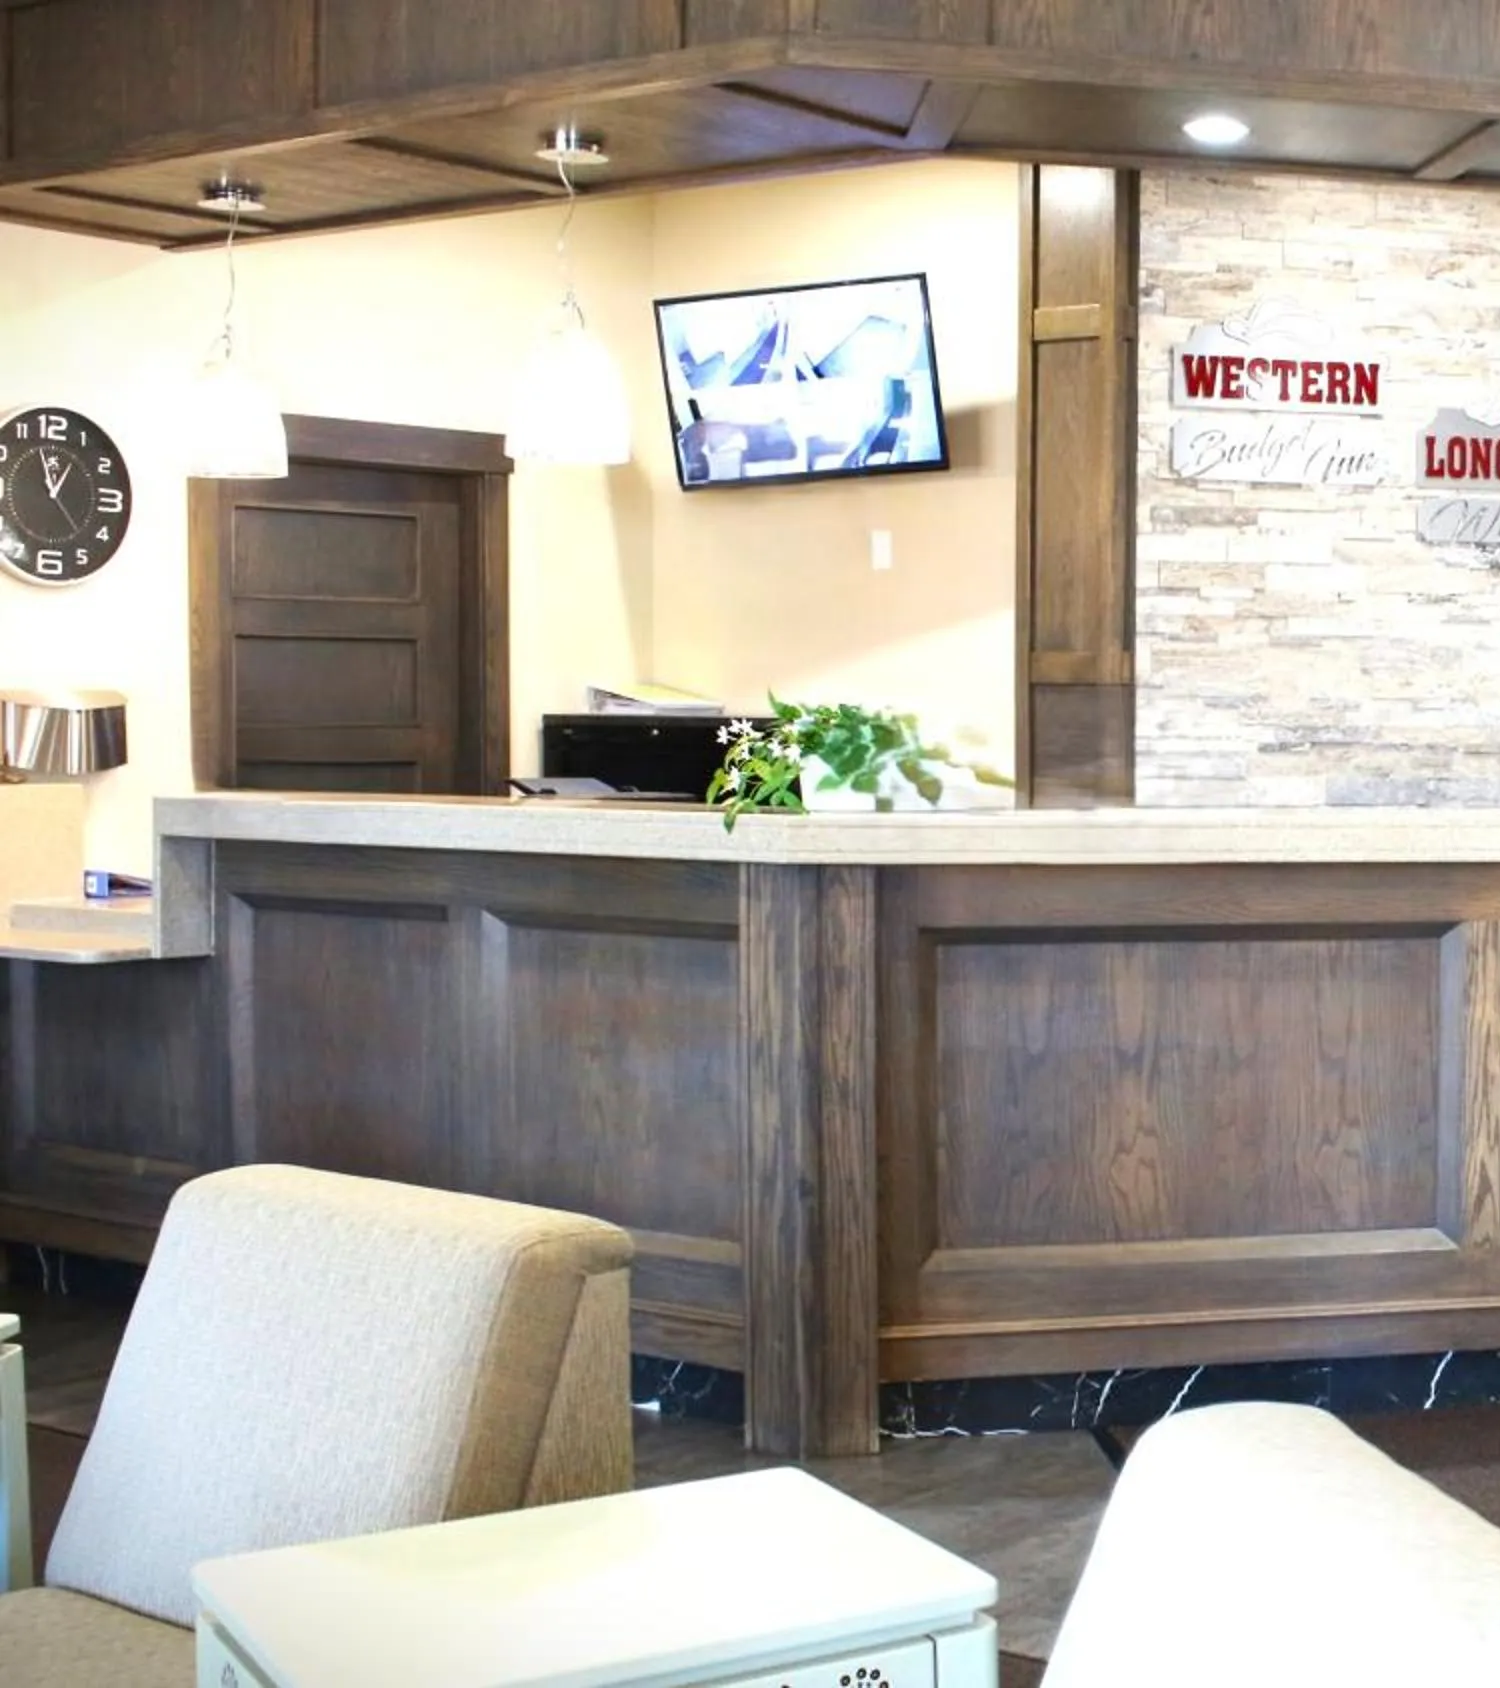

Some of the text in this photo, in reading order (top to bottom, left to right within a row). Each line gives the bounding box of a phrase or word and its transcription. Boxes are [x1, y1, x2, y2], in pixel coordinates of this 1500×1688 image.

[1181, 353, 1380, 406] WESTERN
[16, 423, 28, 439] 11
[38, 414, 68, 441] 12
[80, 431, 86, 447] 1
[98, 457, 111, 474] 2
[97, 487, 123, 513] 3
[95, 525, 109, 542] 4
[37, 549, 63, 575] 6
[76, 548, 88, 565] 5
